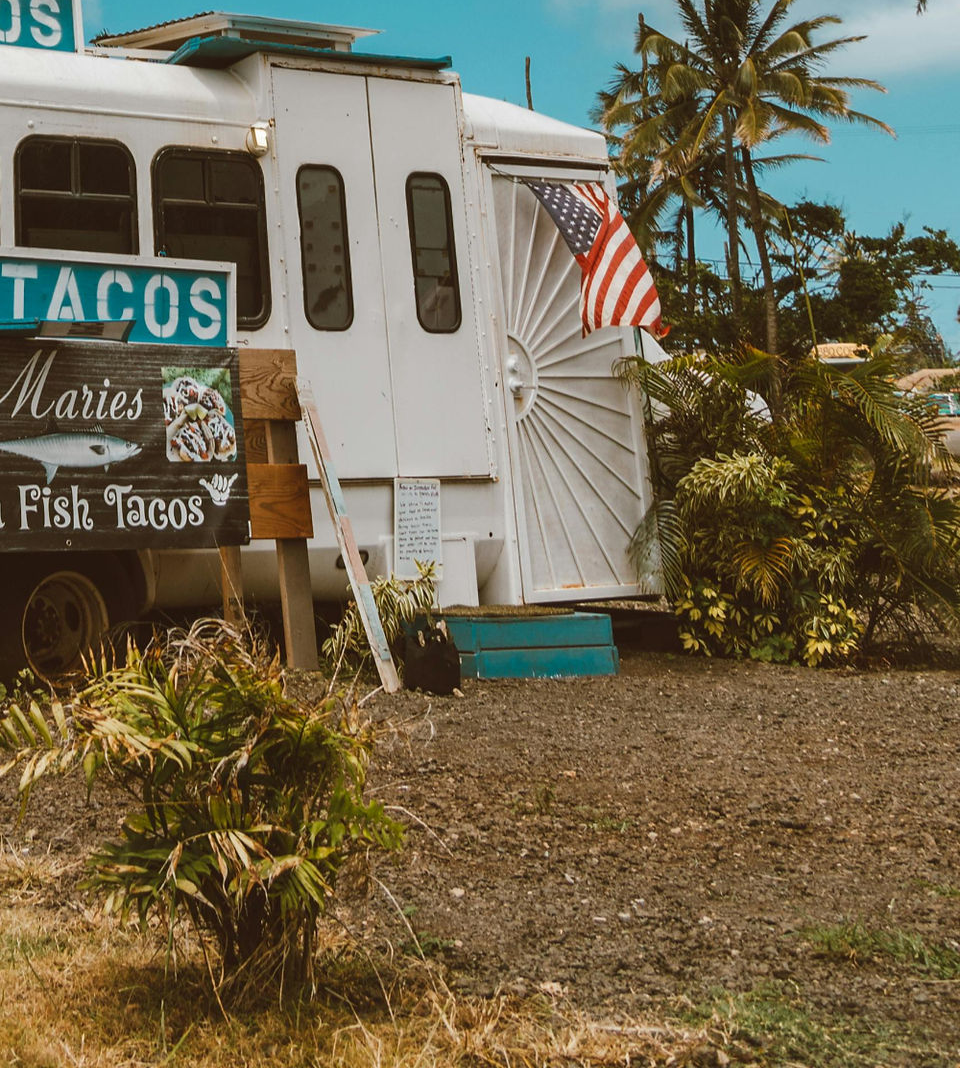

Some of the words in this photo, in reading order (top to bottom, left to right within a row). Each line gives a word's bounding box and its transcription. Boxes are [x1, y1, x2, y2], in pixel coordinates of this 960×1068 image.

[0, 264, 223, 340] TACOS
[17, 484, 94, 531] Fish
[103, 484, 205, 530] Tacos
